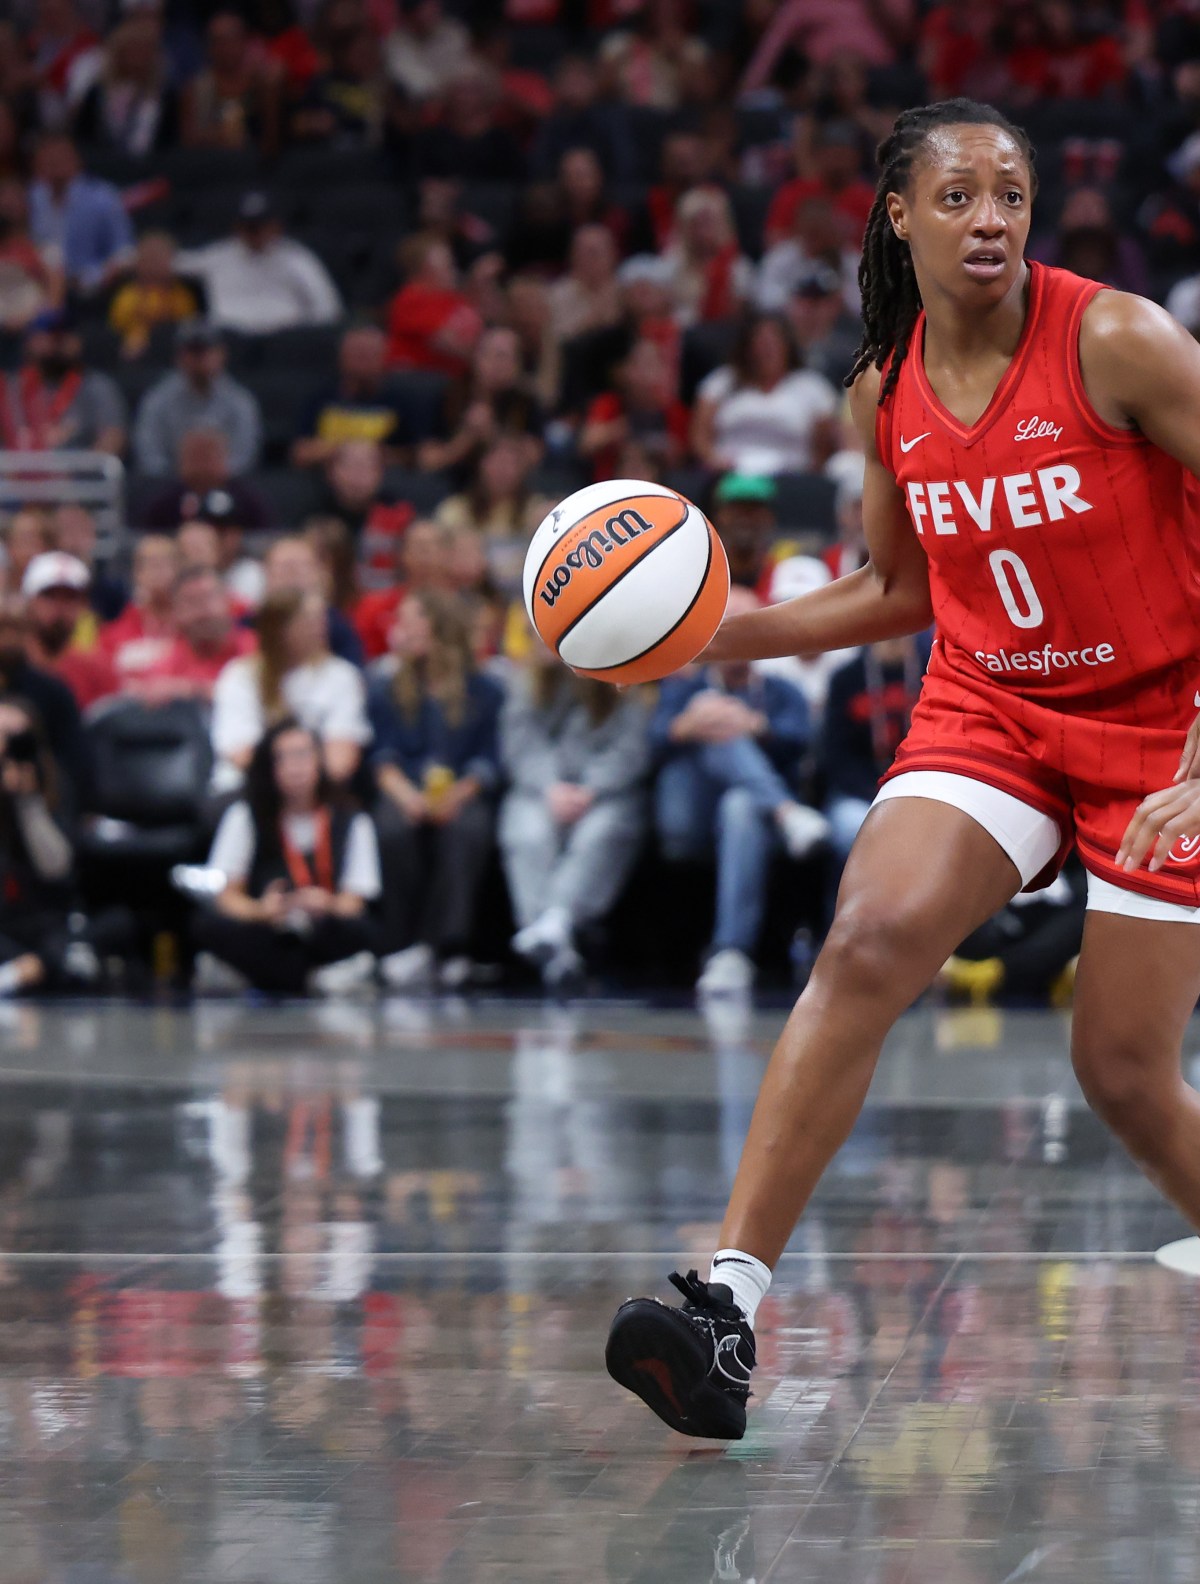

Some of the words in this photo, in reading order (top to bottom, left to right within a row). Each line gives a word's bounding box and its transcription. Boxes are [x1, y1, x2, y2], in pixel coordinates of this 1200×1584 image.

[1013, 415, 1063, 442] Lilly
[906, 464, 1093, 535] FEVER
[540, 508, 654, 607] Wilson
[988, 548, 1044, 629] 0
[974, 642, 1115, 676] salesforce
